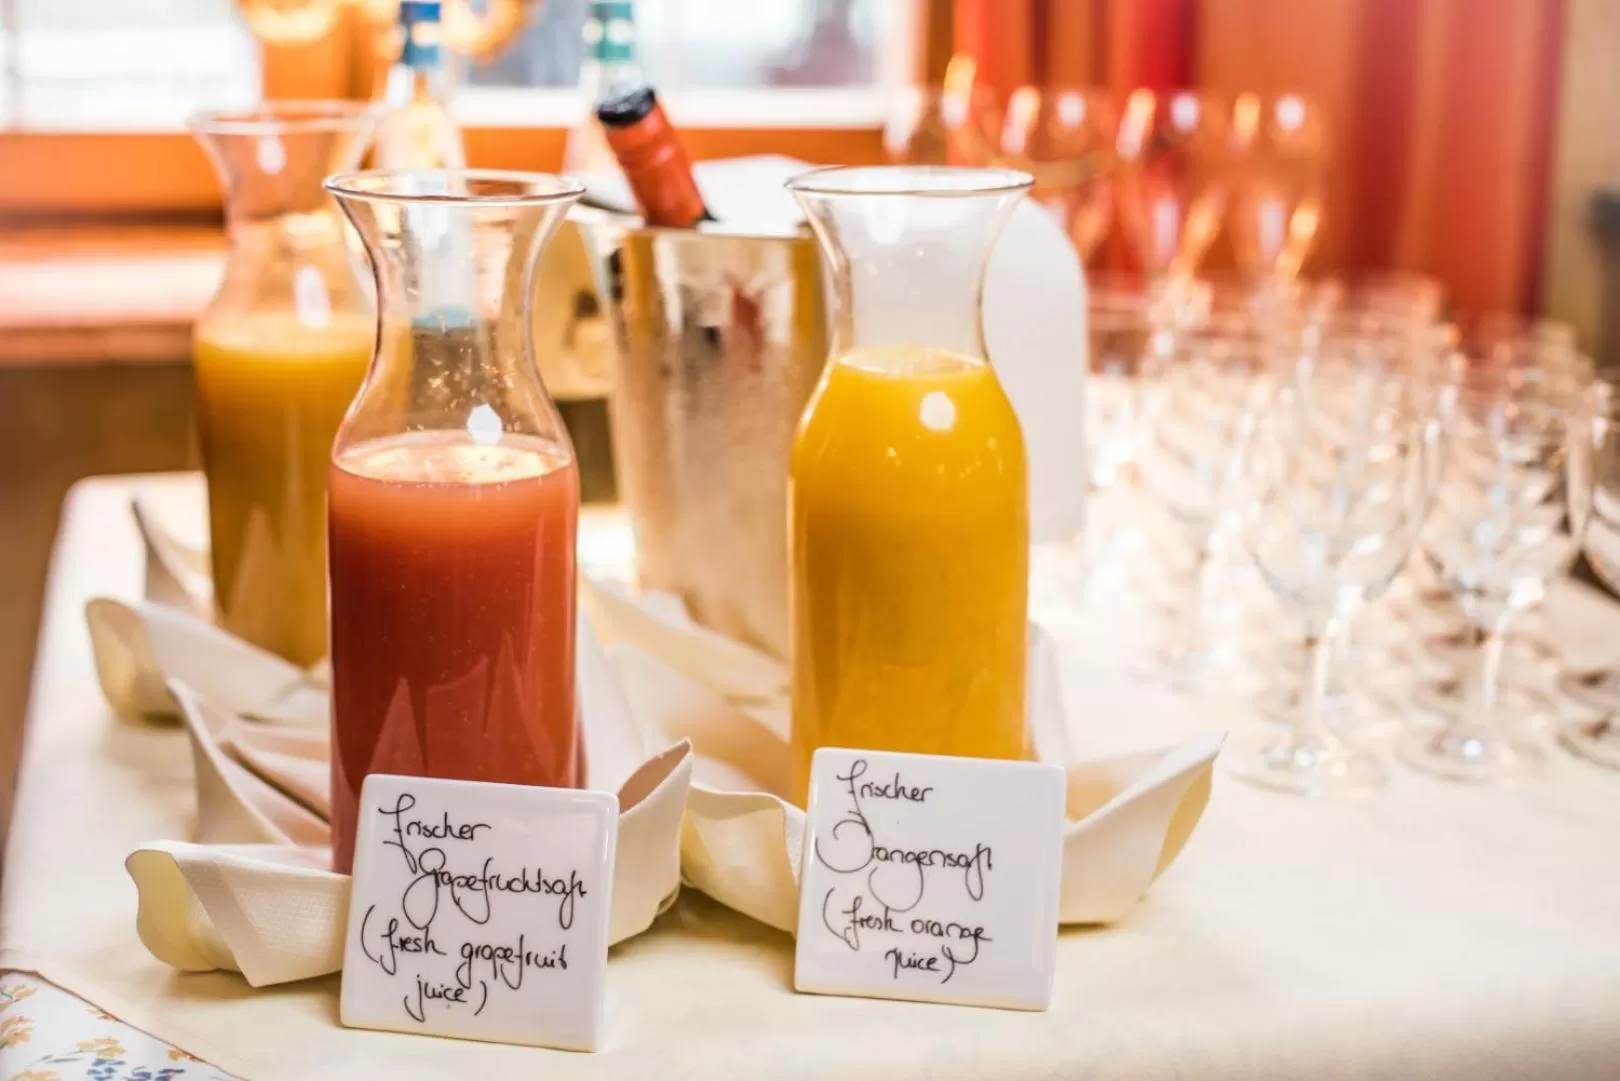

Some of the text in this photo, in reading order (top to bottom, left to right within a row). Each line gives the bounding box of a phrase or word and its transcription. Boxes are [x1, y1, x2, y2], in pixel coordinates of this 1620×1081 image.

[815, 818, 993, 913] Orangensaft
[455, 934, 568, 990] grapefruit
[910, 921, 993, 964] orange
